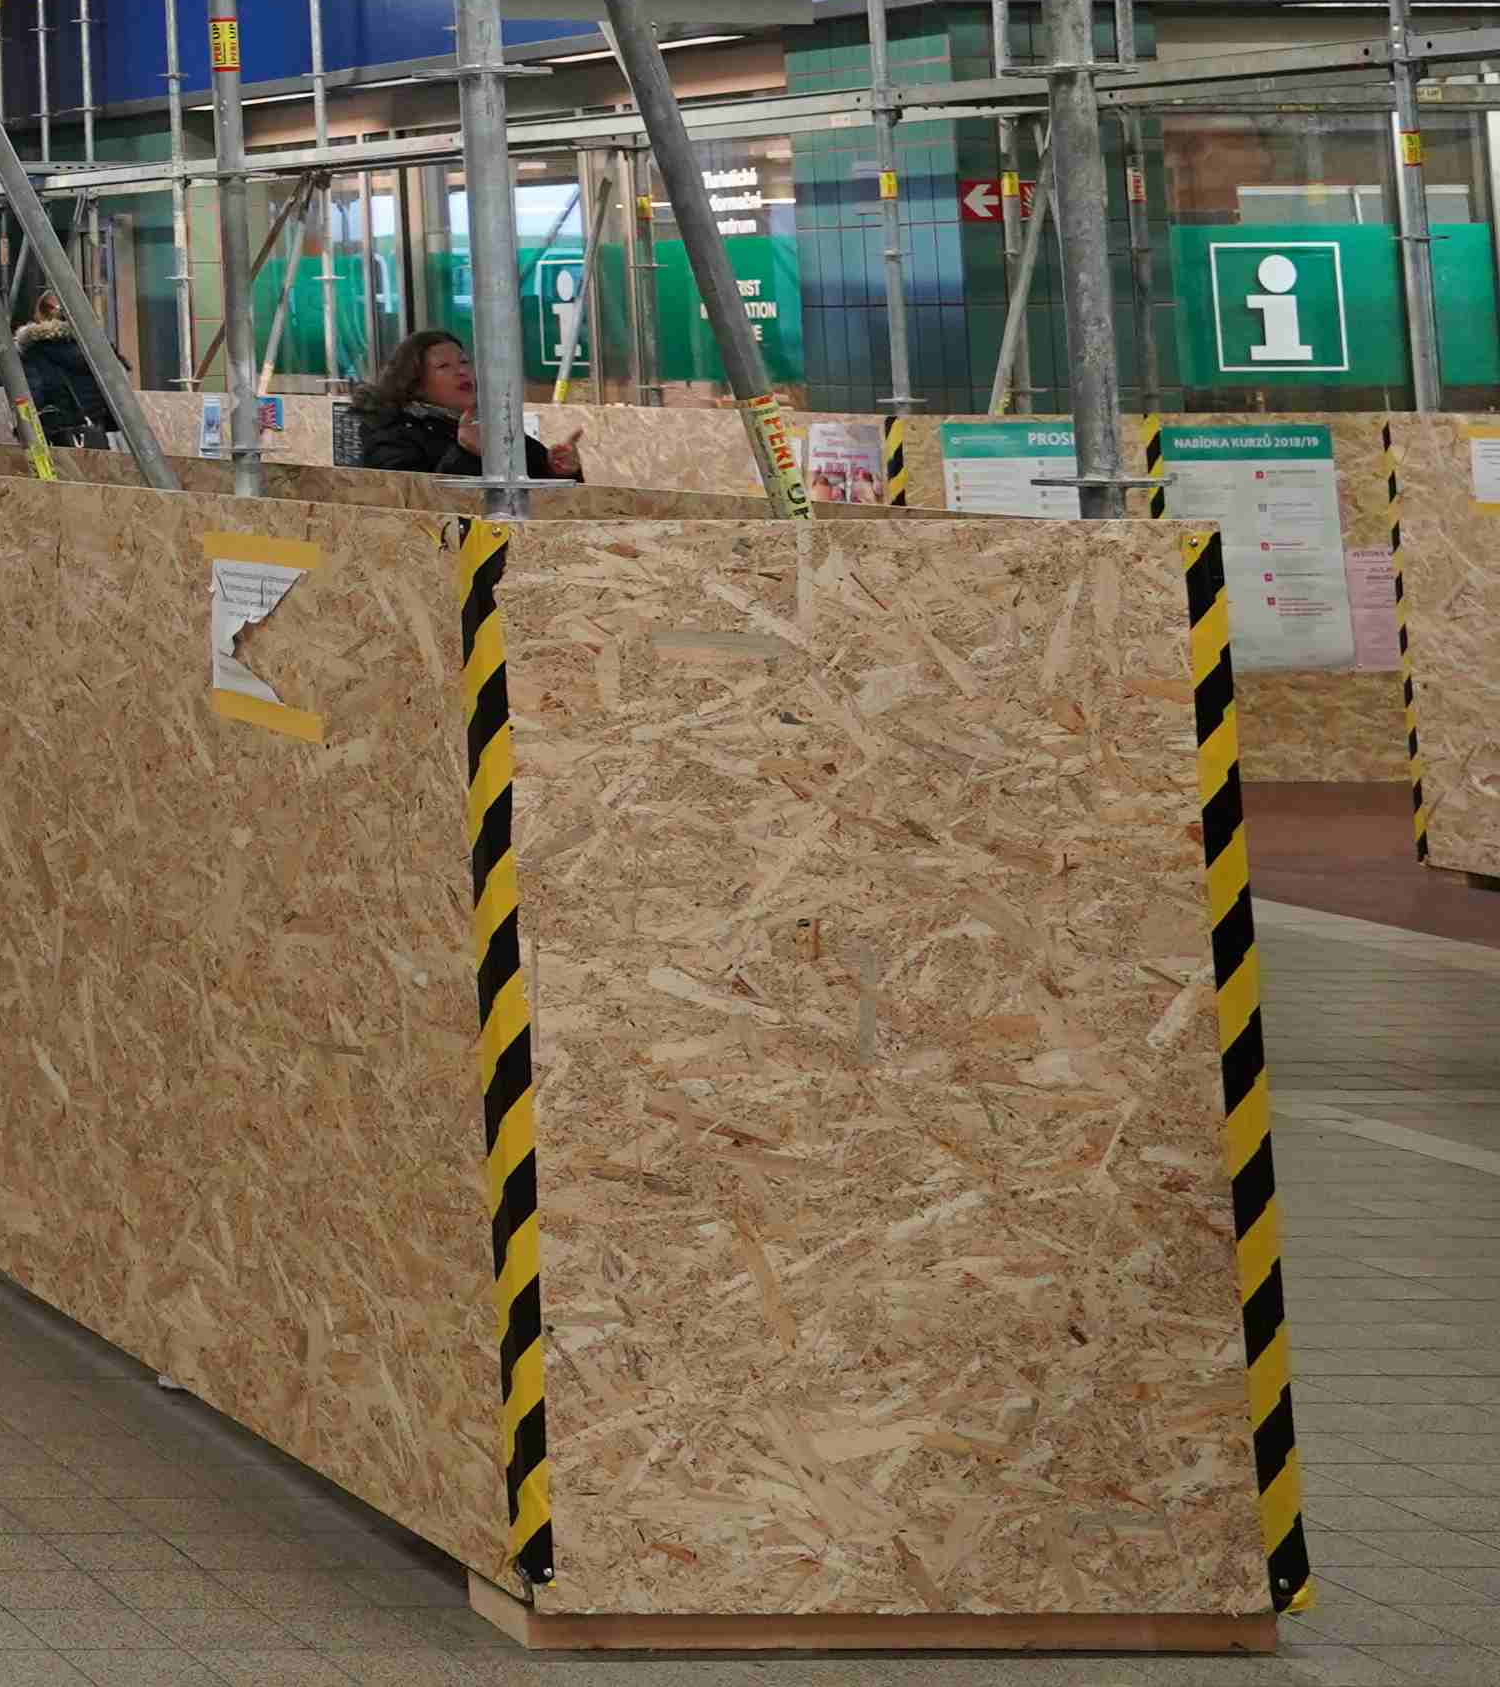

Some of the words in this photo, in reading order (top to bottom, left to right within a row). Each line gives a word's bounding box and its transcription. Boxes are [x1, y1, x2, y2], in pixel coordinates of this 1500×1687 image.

[211, 23, 221, 40] UP
[212, 42, 222, 63] PERI
[764, 416, 796, 471] PERI
[1174, 436, 1230, 449] NABÍDKA
[1232, 433, 1273, 448] KURZŮ
